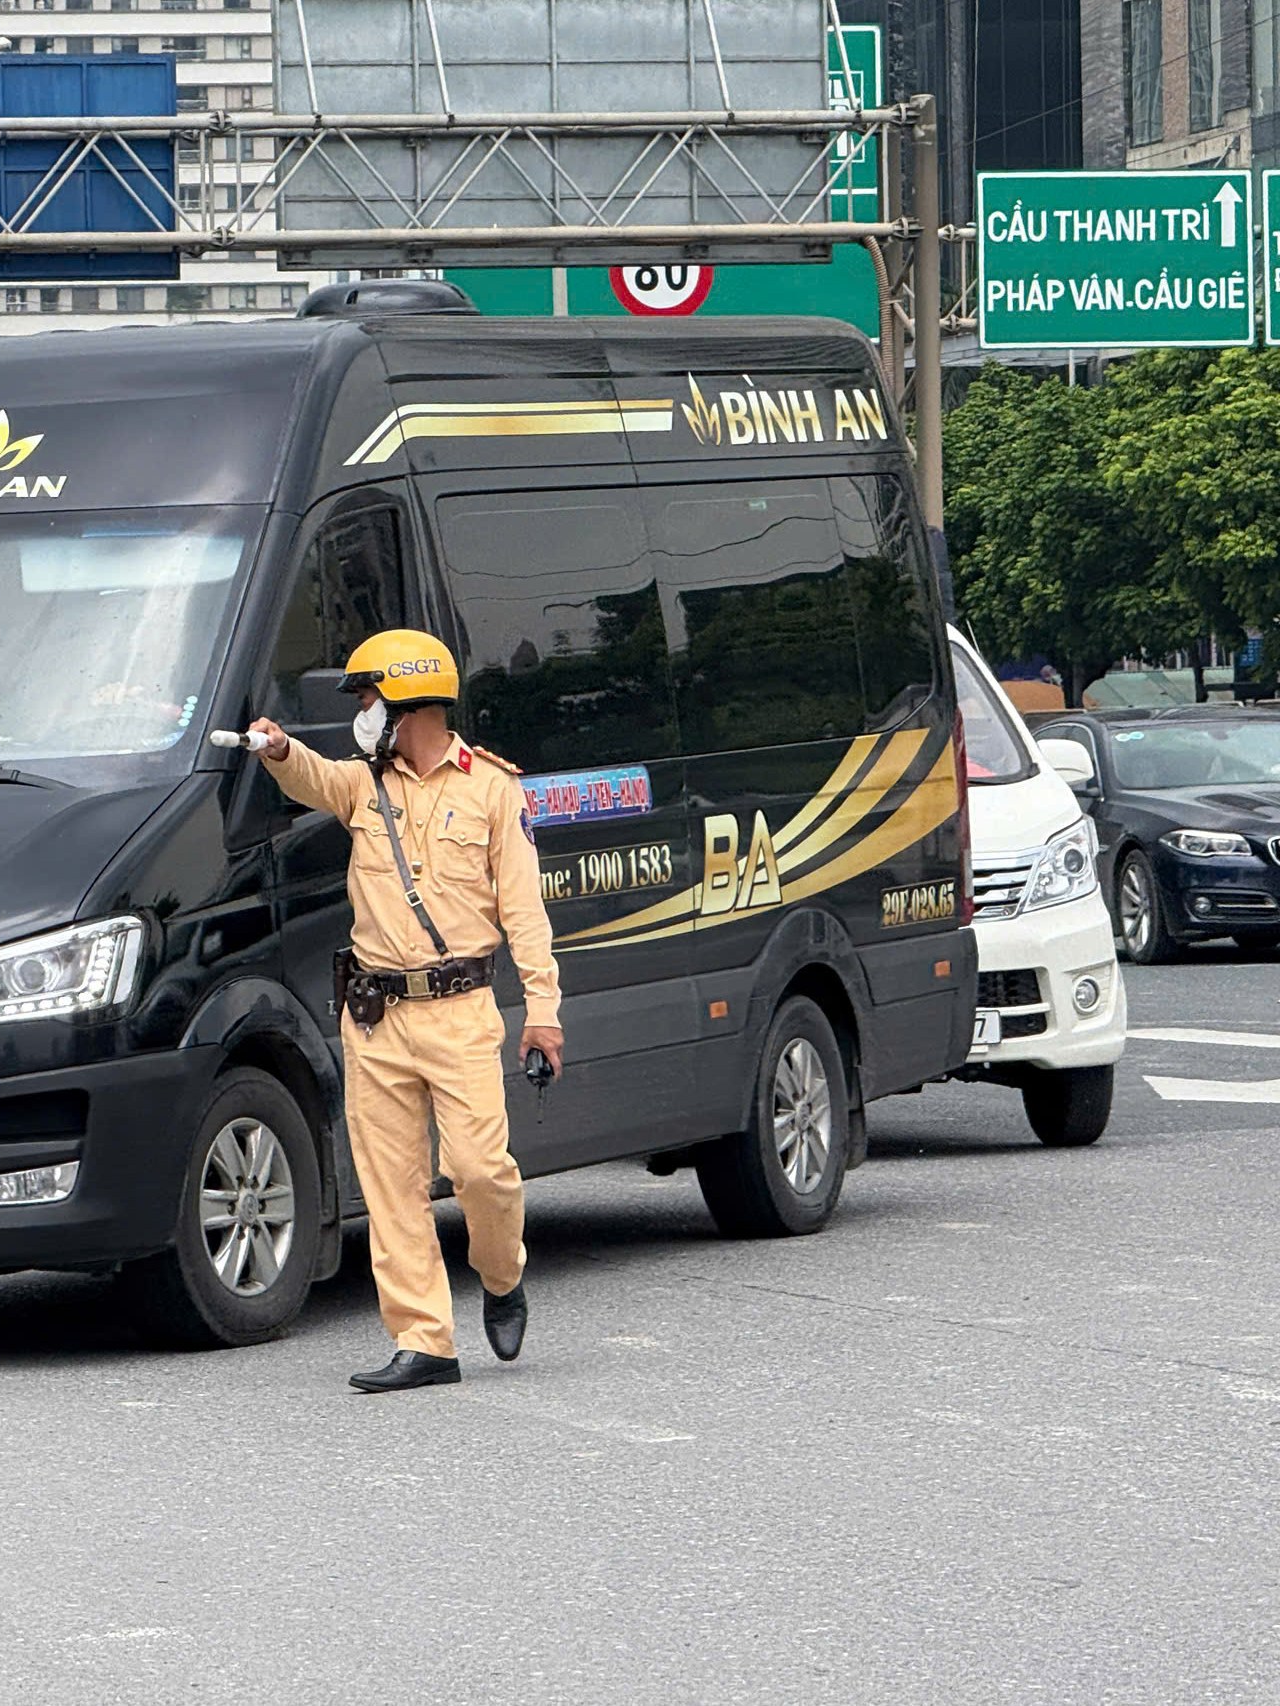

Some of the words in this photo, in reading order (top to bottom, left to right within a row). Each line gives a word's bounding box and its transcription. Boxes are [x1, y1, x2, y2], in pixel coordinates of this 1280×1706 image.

[987, 200, 1048, 242] CẦU
[1053, 209, 1156, 242] THANH
[1161, 203, 1210, 241] TRÌ
[987, 272, 1065, 312] PHÁP
[719, 374, 825, 445] BÌNH
[834, 388, 888, 442] AN
[388, 659, 441, 678] CSGT
[577, 851, 624, 895] 1900
[627, 844, 673, 888] 1583
[701, 809, 783, 915] BA
[882, 882, 955, 926] 29F-028.65
